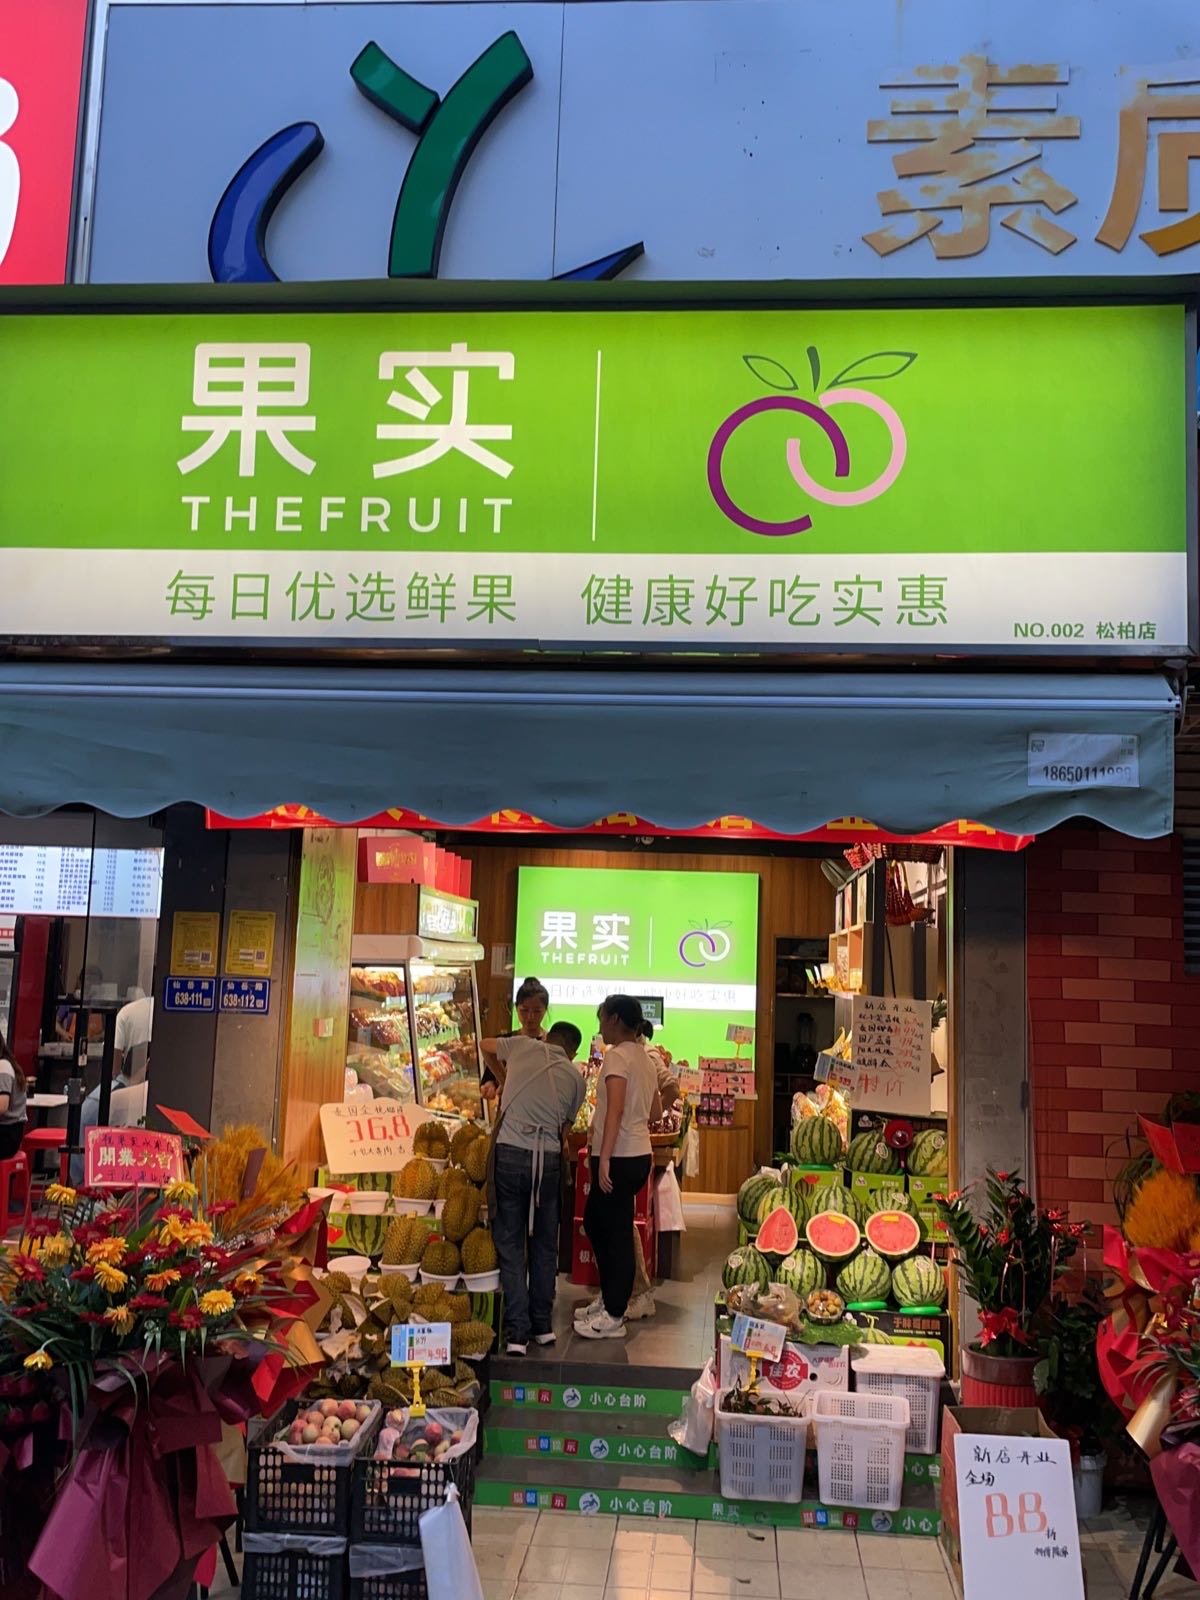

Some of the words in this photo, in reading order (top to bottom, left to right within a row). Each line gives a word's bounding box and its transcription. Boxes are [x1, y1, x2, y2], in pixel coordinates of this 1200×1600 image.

[177, 341, 515, 479] 果实
[182, 496, 514, 534] THEFRUIT
[165, 568, 517, 625] 每日优选鲜果
[581, 572, 950, 627] 健康好吃实惠
[1014, 621, 1085, 640] NO.002
[1096, 621, 1157, 642] 松柏店
[539, 911, 631, 951] 果实
[541, 952, 630, 966] THEFRUIT
[346, 1114, 411, 1143] 36.8
[769, 1362, 801, 1379] 佳农
[590, 1392, 647, 1408] 小心台阶
[618, 1442, 678, 1460] 小心台阶
[973, 1445, 1057, 1466] 新店开业
[609, 1497, 673, 1515] 小心台阶
[902, 1516, 940, 1534] 小心
